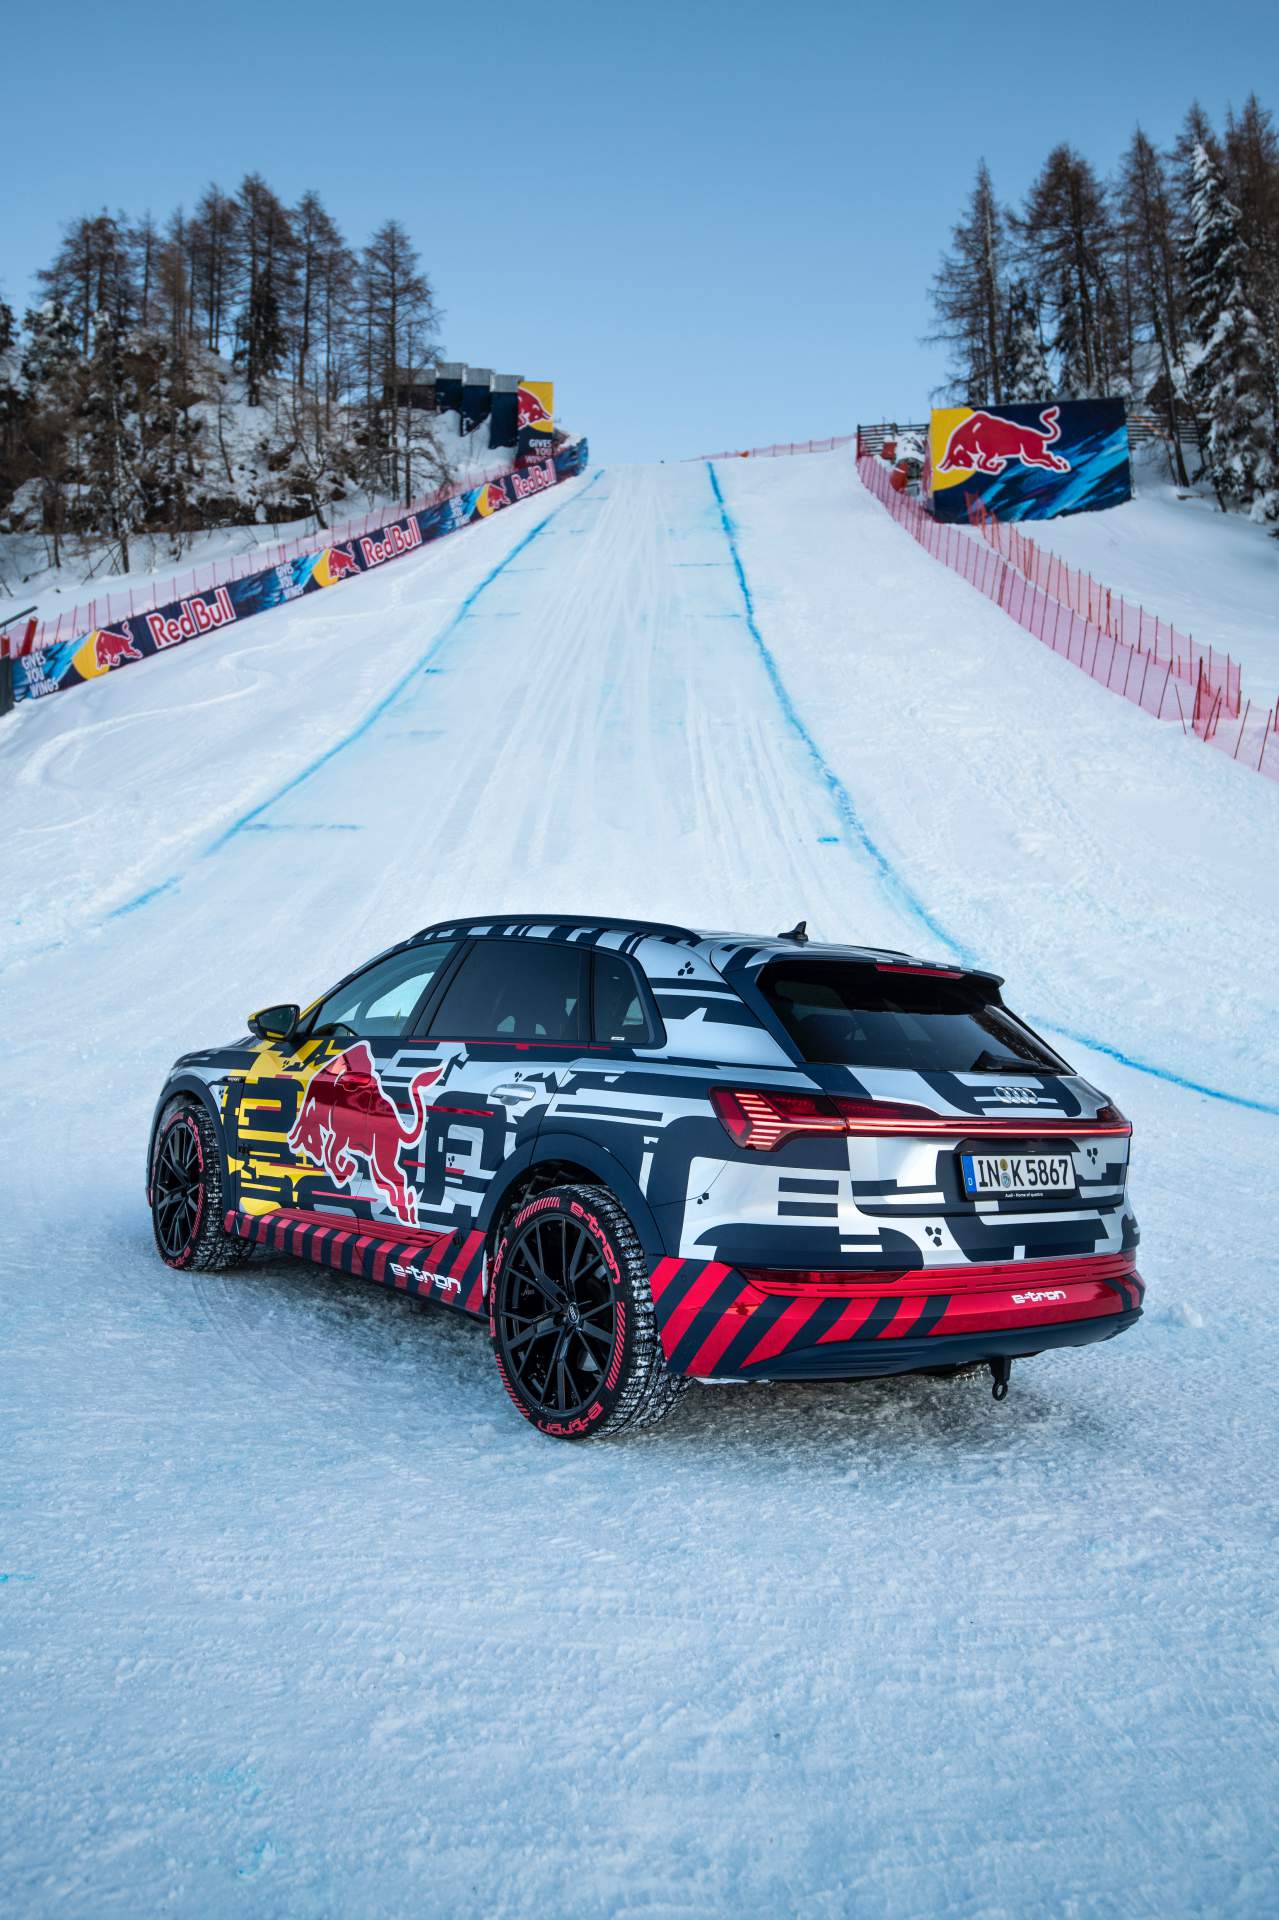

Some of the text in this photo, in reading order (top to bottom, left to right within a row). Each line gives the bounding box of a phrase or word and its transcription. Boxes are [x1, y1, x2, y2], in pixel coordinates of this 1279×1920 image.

[529, 439, 552, 448] GIVES
[511, 458, 557, 499] Red Bull
[361, 515, 422, 567] Red Bull
[145, 586, 237, 649] Red Bull
[21, 650, 46, 670] GIVES
[26, 666, 45, 684] YOU
[30, 677, 60, 698] WINGS
[978, 1159, 1001, 1188] IN
[1011, 1159, 1025, 1187] K
[1026, 1158, 1069, 1186] 5867
[570, 1201, 621, 1285] e-tron
[388, 1262, 462, 1294] e-tron
[1011, 1290, 1067, 1304] e-tron
